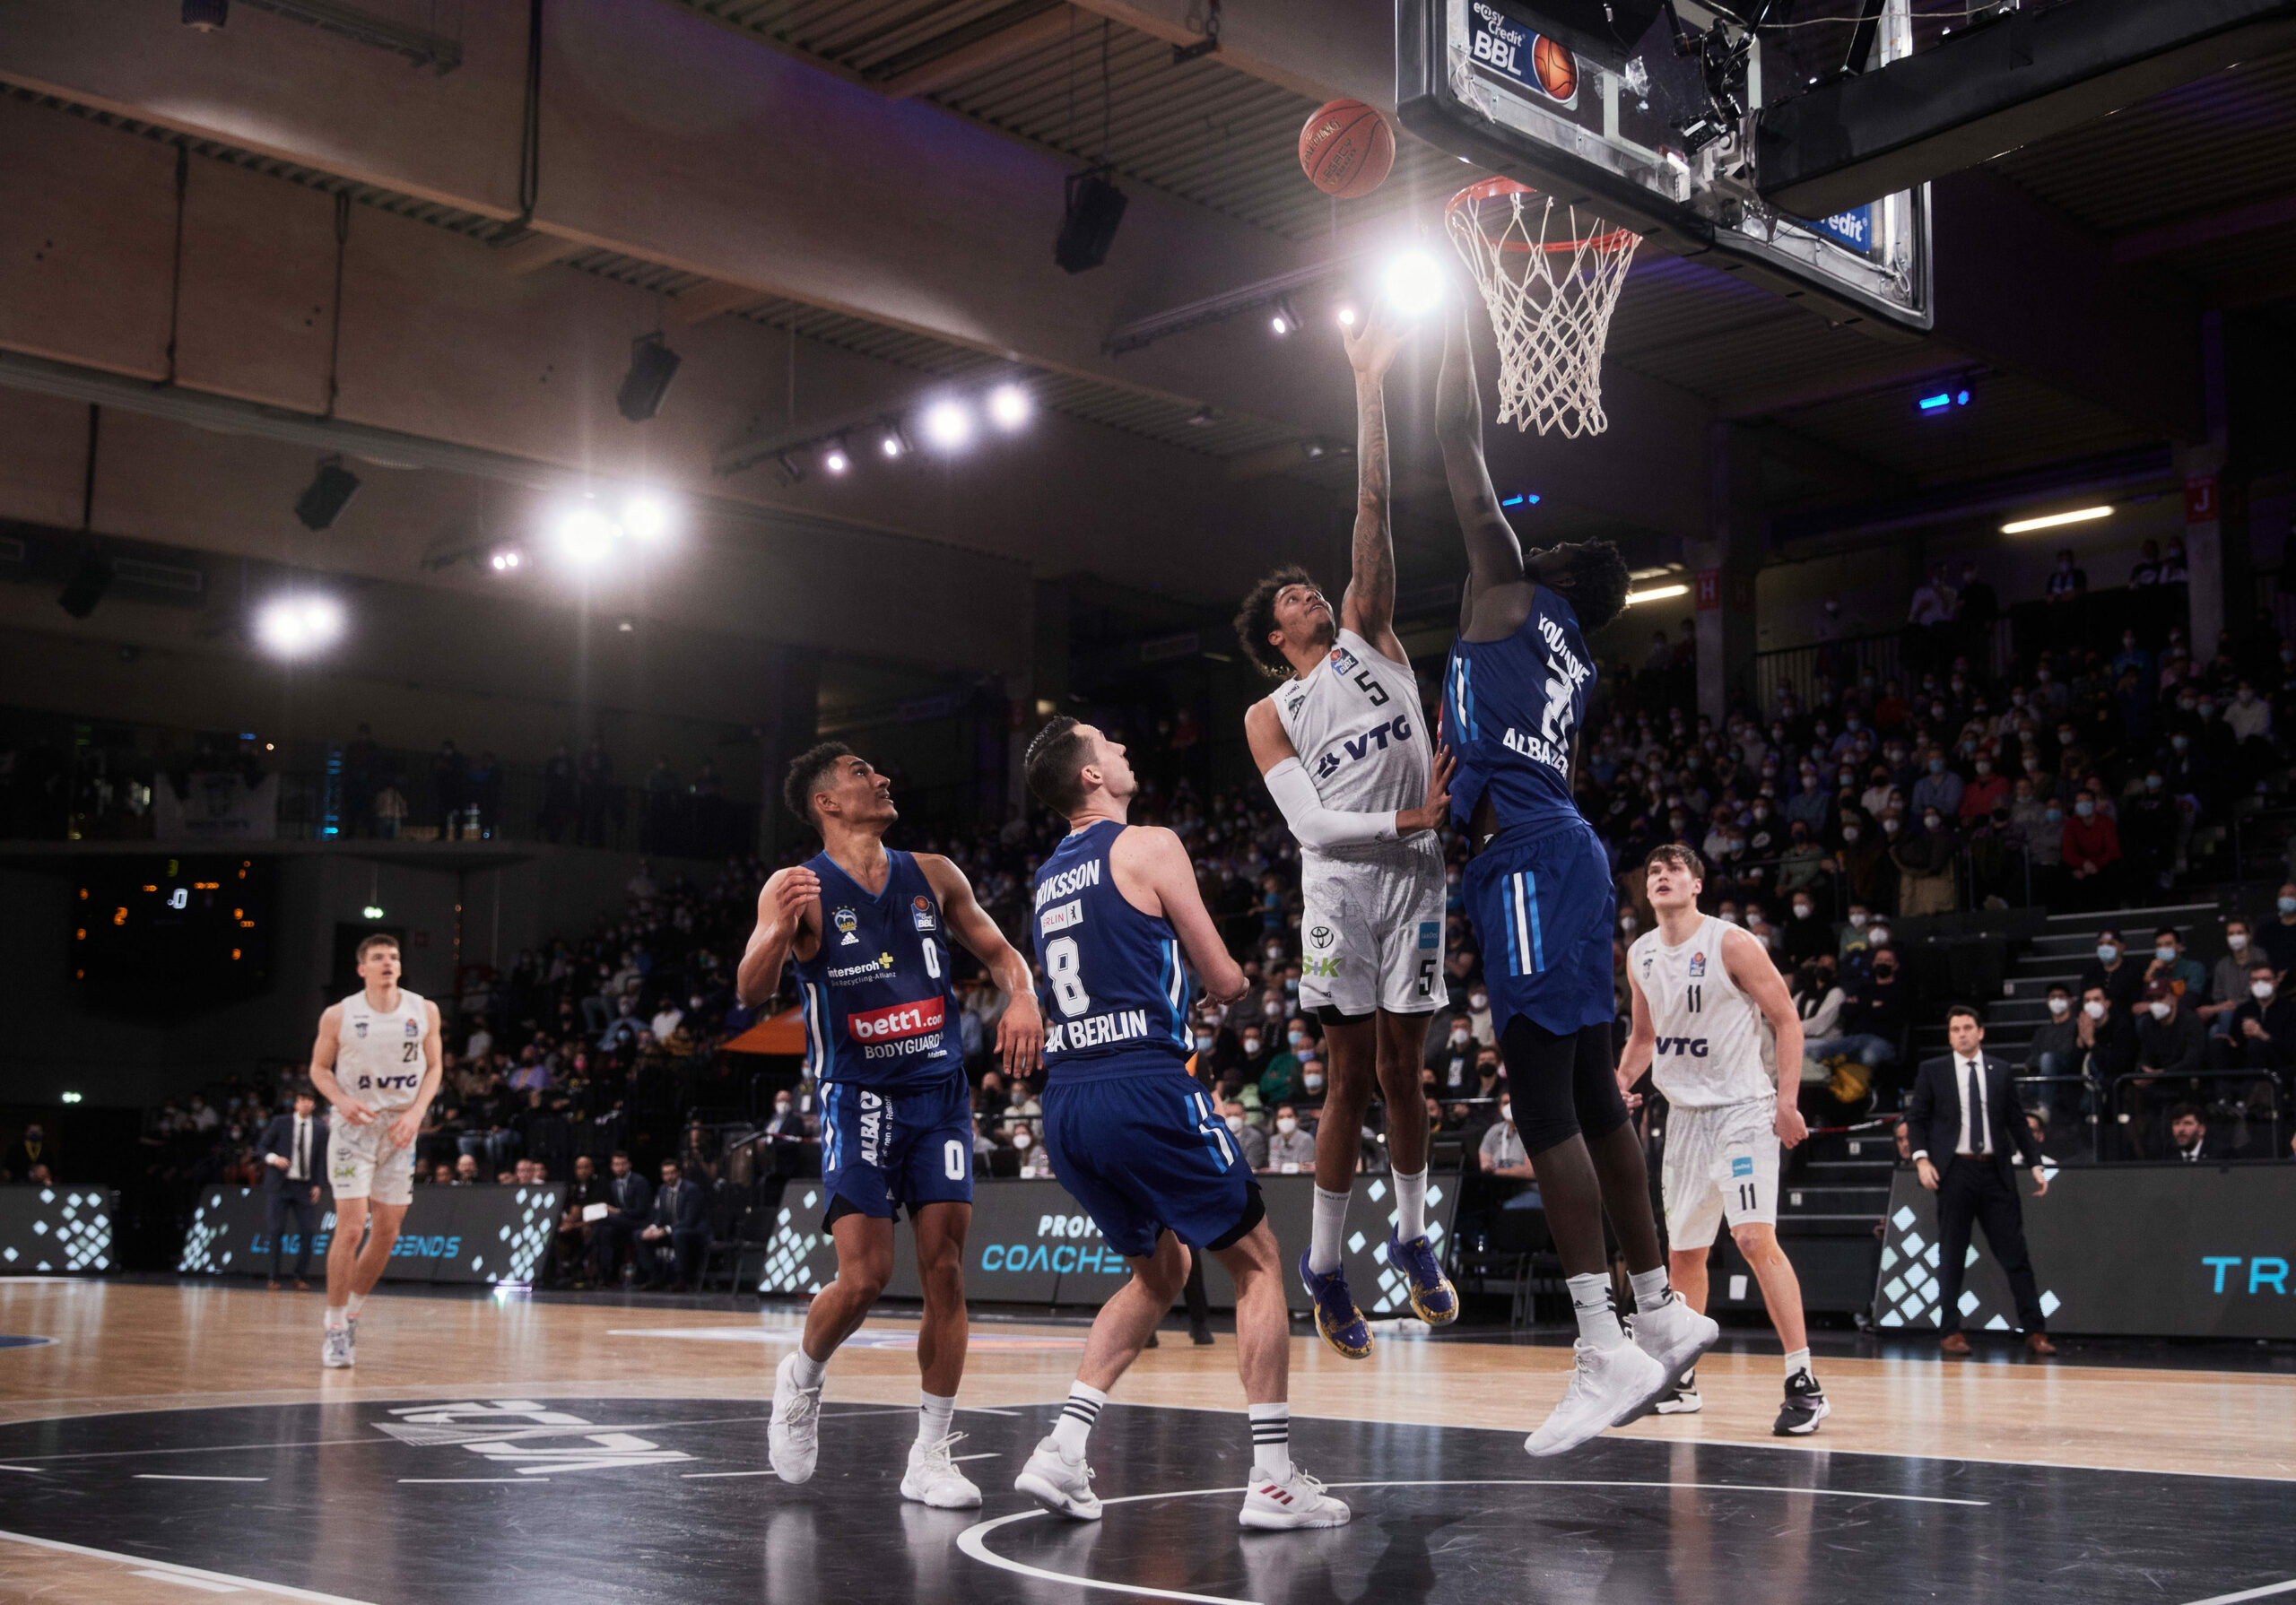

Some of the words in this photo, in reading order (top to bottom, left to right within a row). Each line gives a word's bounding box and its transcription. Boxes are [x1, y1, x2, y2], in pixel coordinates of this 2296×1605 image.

[1474, 30, 1522, 76] BBL
[1821, 213, 1863, 242] edit
[2195, 487, 2209, 512] J
[1700, 578, 1715, 600] H
[1354, 670, 1390, 707] 5
[1344, 714, 1412, 761] VTG
[918, 919, 934, 928] BBL
[827, 960, 880, 977] interseroh
[922, 938, 941, 979] 0
[1046, 936, 1091, 1018] 8
[1419, 959, 1437, 995] 5
[1687, 985, 1700, 1012] 11
[1067, 1010, 1148, 1049] BERLIN
[403, 1042, 418, 1063] 21
[1656, 1036, 1709, 1058] VTG
[377, 1074, 417, 1089] VTG
[860, 1111, 881, 1167] ALBA
[944, 1140, 965, 1181] 0
[1739, 1183, 1756, 1210] 11
[981, 1244, 1132, 1274] COACHE
[2201, 1256, 2296, 1295] TR
